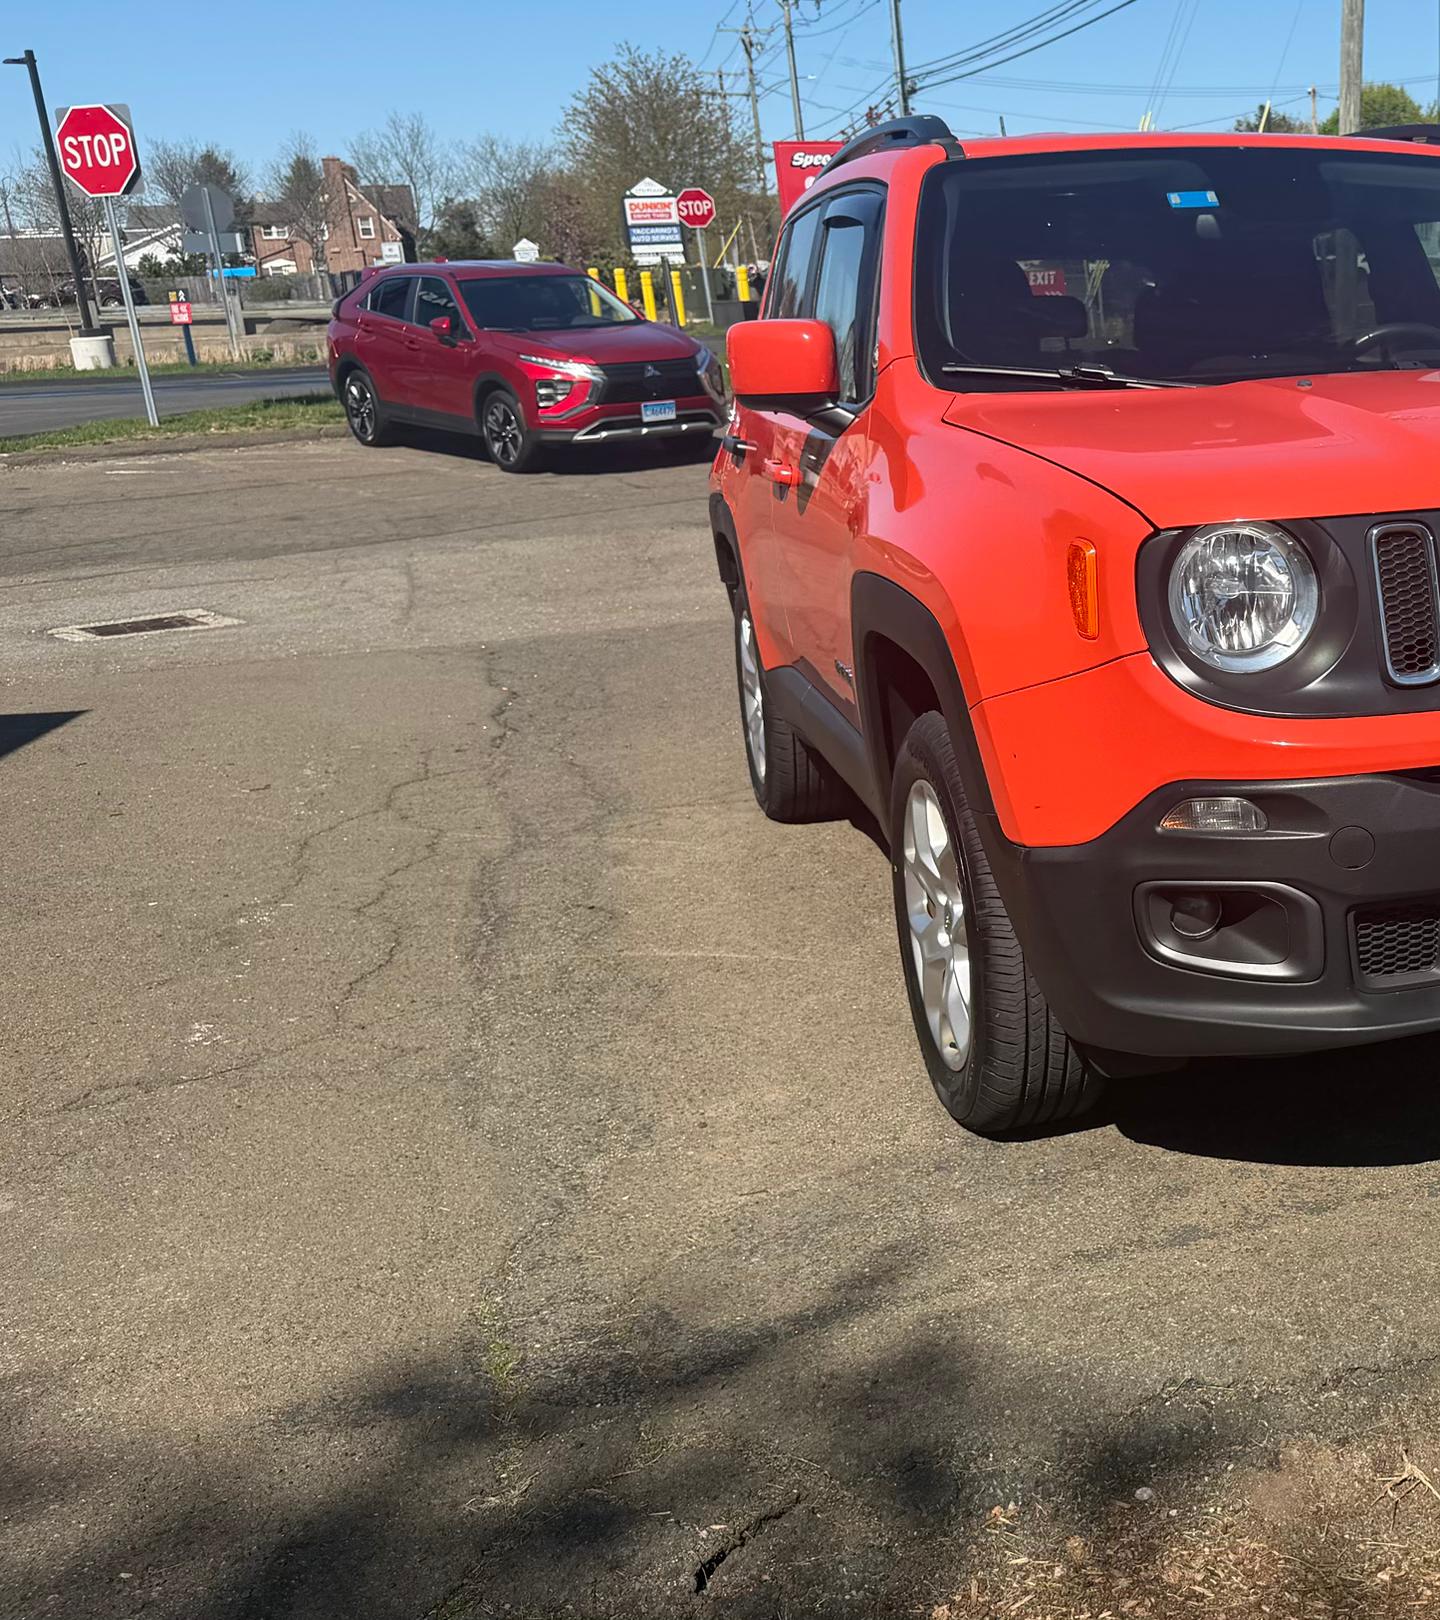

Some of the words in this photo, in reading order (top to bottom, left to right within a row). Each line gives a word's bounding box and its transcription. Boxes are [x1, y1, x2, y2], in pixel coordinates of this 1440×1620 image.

[64, 133, 126, 170] STOP
[791, 151, 832, 169] Spee
[678, 200, 712, 217] STOP
[1029, 271, 1056, 286] EXIT
